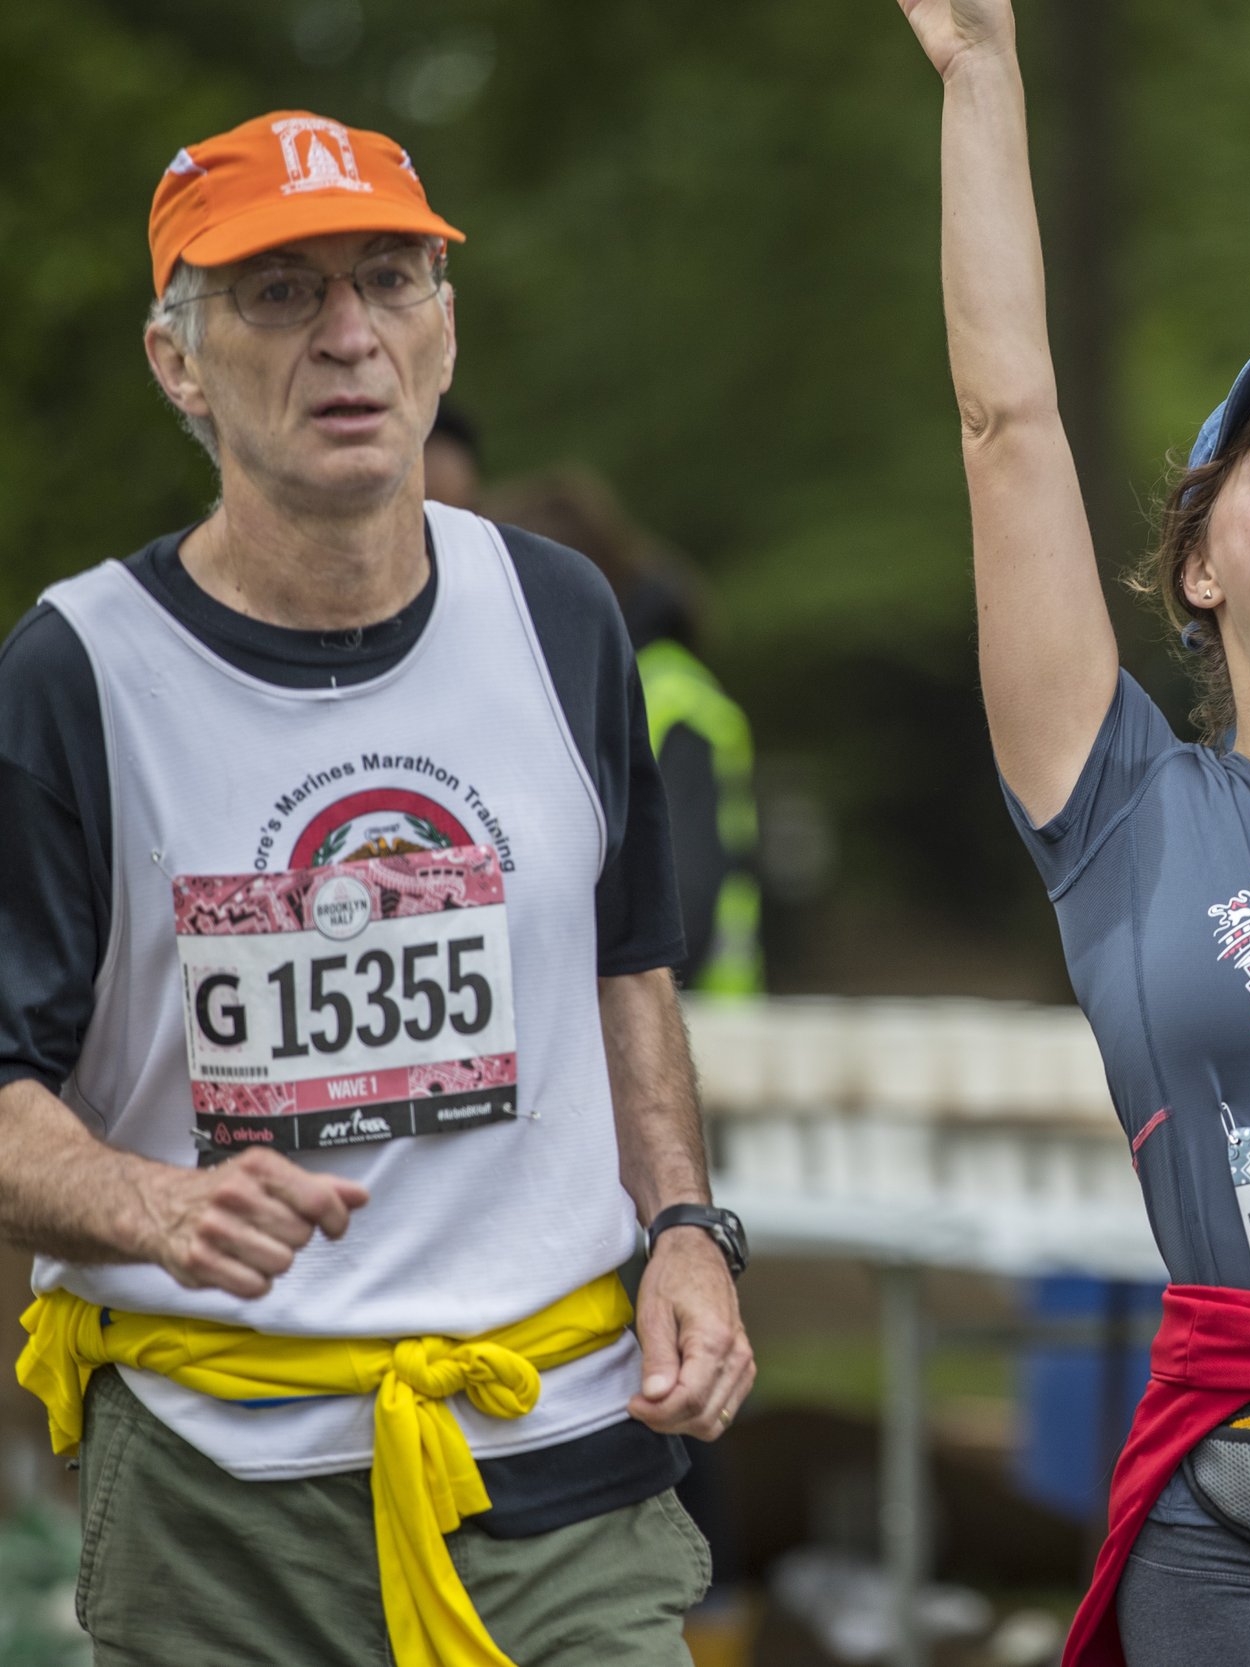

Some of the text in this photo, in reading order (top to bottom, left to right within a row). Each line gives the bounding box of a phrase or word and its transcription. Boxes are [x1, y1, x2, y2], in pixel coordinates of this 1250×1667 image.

[274, 761, 355, 816] Marines
[361, 753, 461, 790] Marathon
[463, 785, 516, 873] Training
[316, 900, 367, 916] BROOKLYN
[330, 909, 353, 926] HALF
[196, 973, 247, 1047] G
[268, 935, 492, 1059] 15355
[327, 1076, 377, 1100] WAVE 1
[233, 1126, 274, 1143] airbnb
